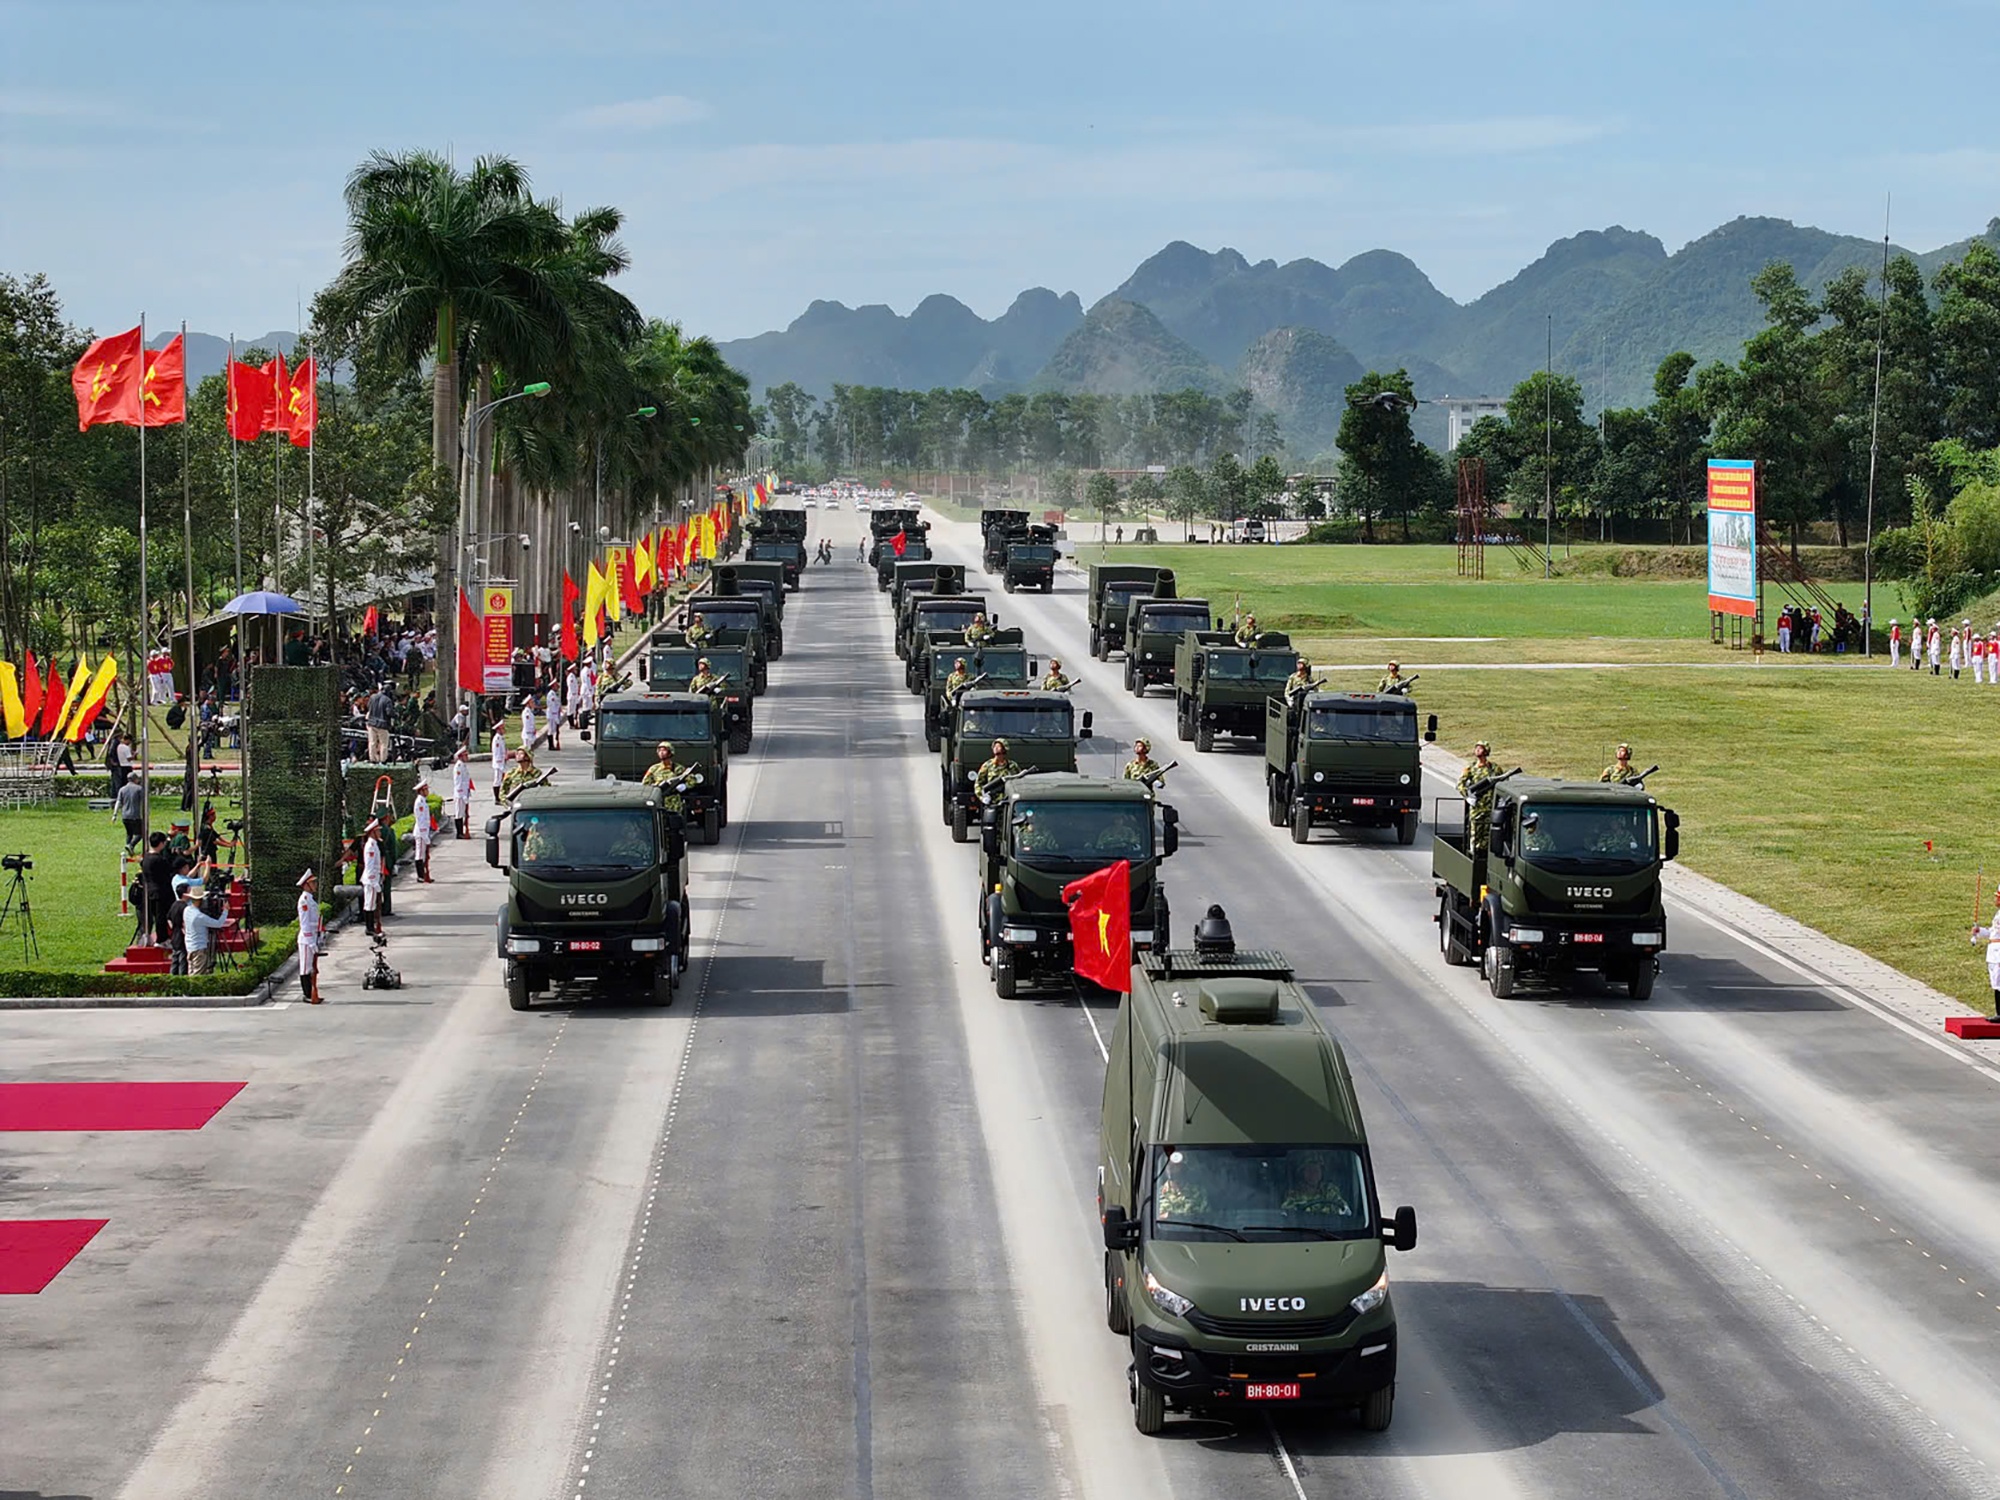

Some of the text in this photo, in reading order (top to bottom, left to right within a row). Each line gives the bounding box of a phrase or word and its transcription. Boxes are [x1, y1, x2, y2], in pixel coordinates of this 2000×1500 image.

[1567, 887, 1613, 898] IVECO
[560, 893, 608, 904] IVECO
[1240, 1297, 1306, 1311] IVECO
[1246, 1343, 1300, 1352] CRISTANINI
[1247, 1384, 1297, 1398] BH-80-01
